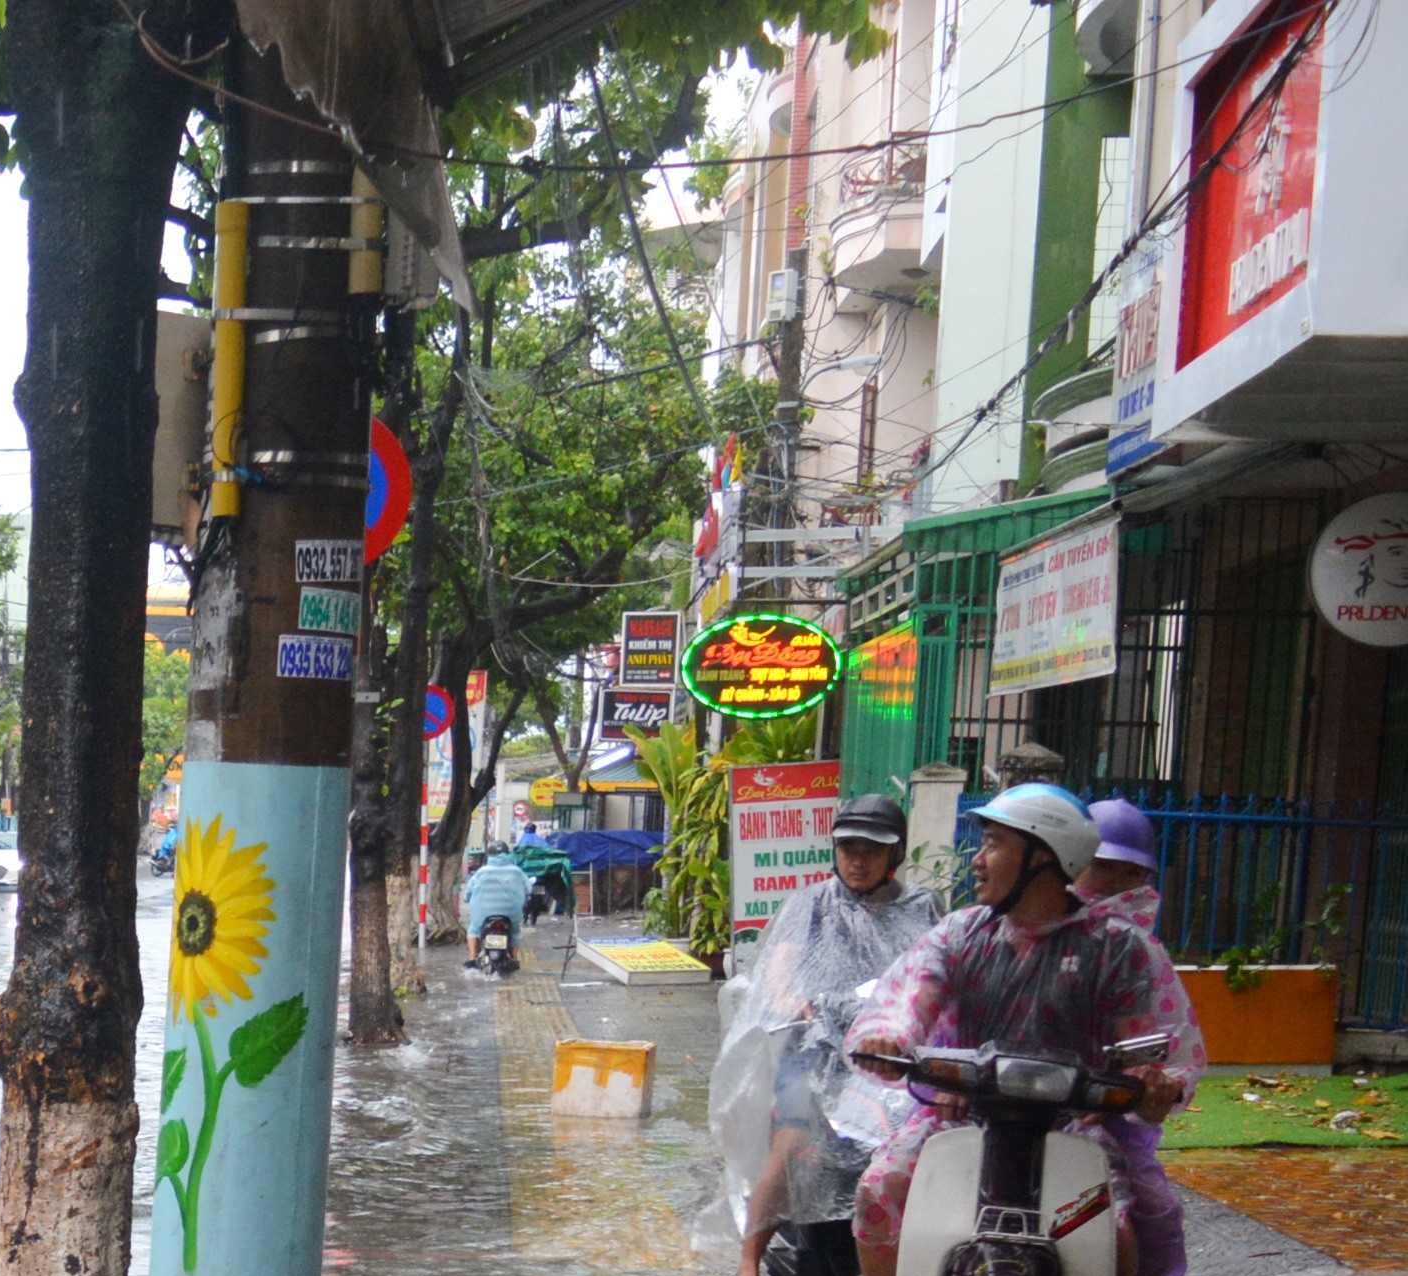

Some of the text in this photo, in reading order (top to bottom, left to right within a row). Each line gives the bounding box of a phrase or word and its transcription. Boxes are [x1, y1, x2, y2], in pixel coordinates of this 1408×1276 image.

[628, 653, 647, 665] ANH
[739, 806, 767, 841] BÁNH
[770, 803, 803, 838] TRÁNG
[754, 844, 835, 868] MÌ QUẢN
[753, 875, 798, 892] RAM
[745, 899, 768, 917] XÁO
